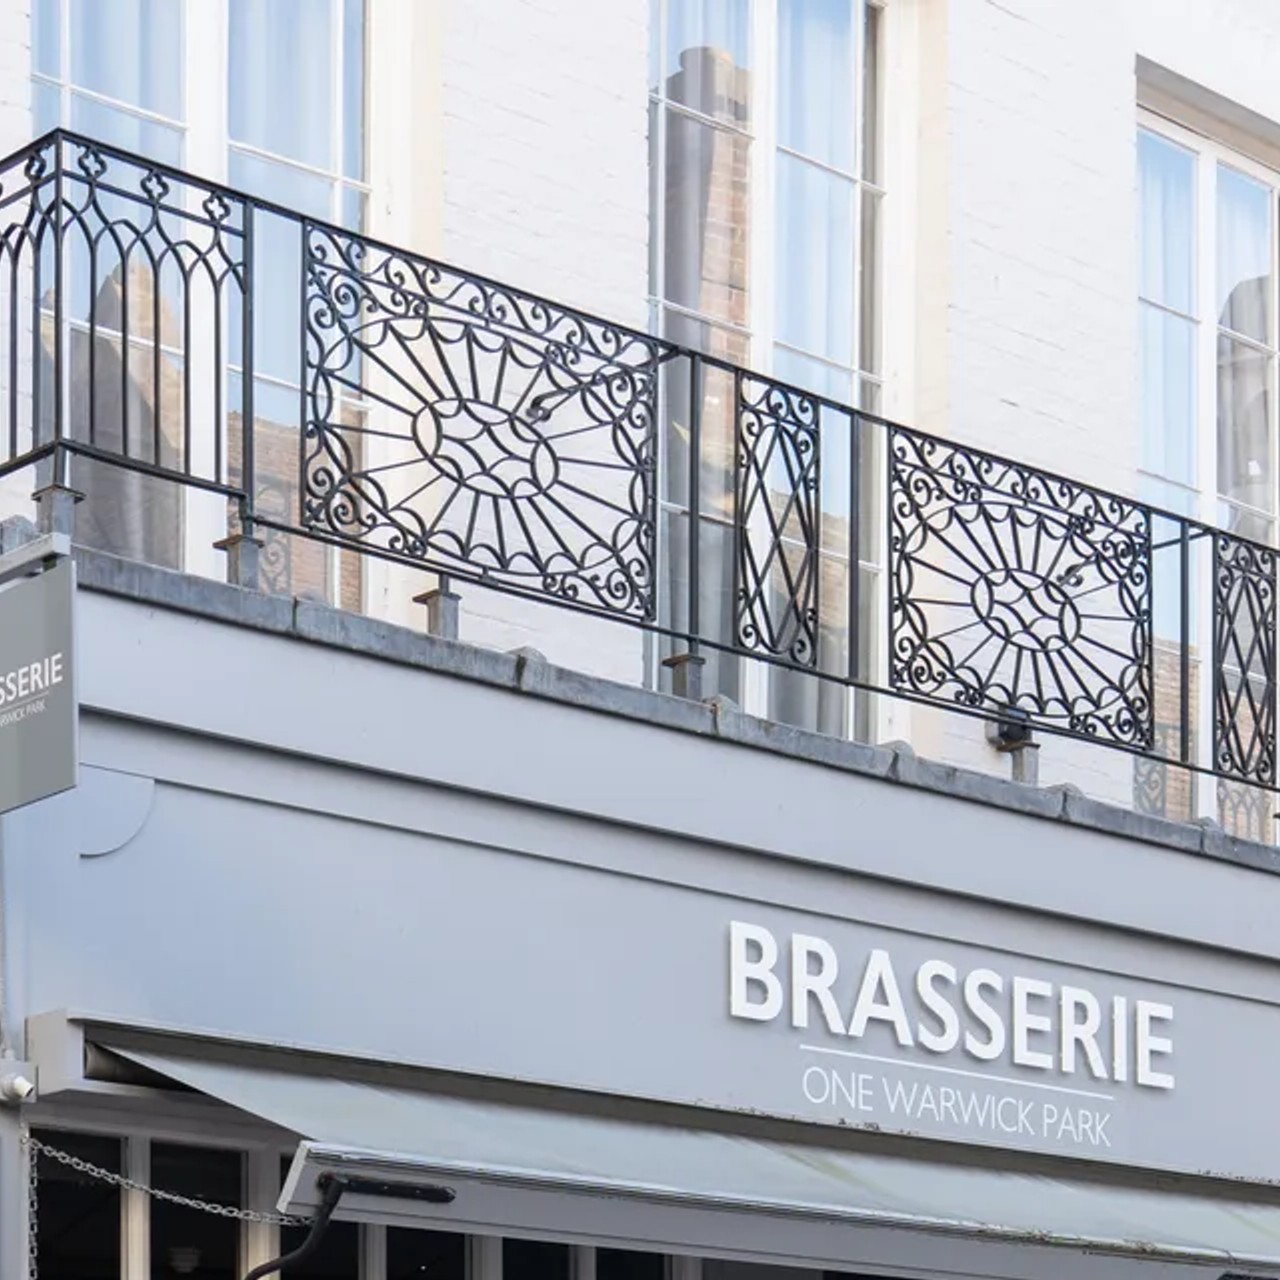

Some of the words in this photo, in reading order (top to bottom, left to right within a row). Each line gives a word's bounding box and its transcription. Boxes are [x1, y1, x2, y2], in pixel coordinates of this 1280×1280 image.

[25, 698, 47, 716] PARK
[729, 919, 1176, 1090] BRASSERIE
[801, 1066, 874, 1113] ONE
[881, 1076, 1035, 1137] WARWICK
[1043, 1104, 1112, 1148] PARK
